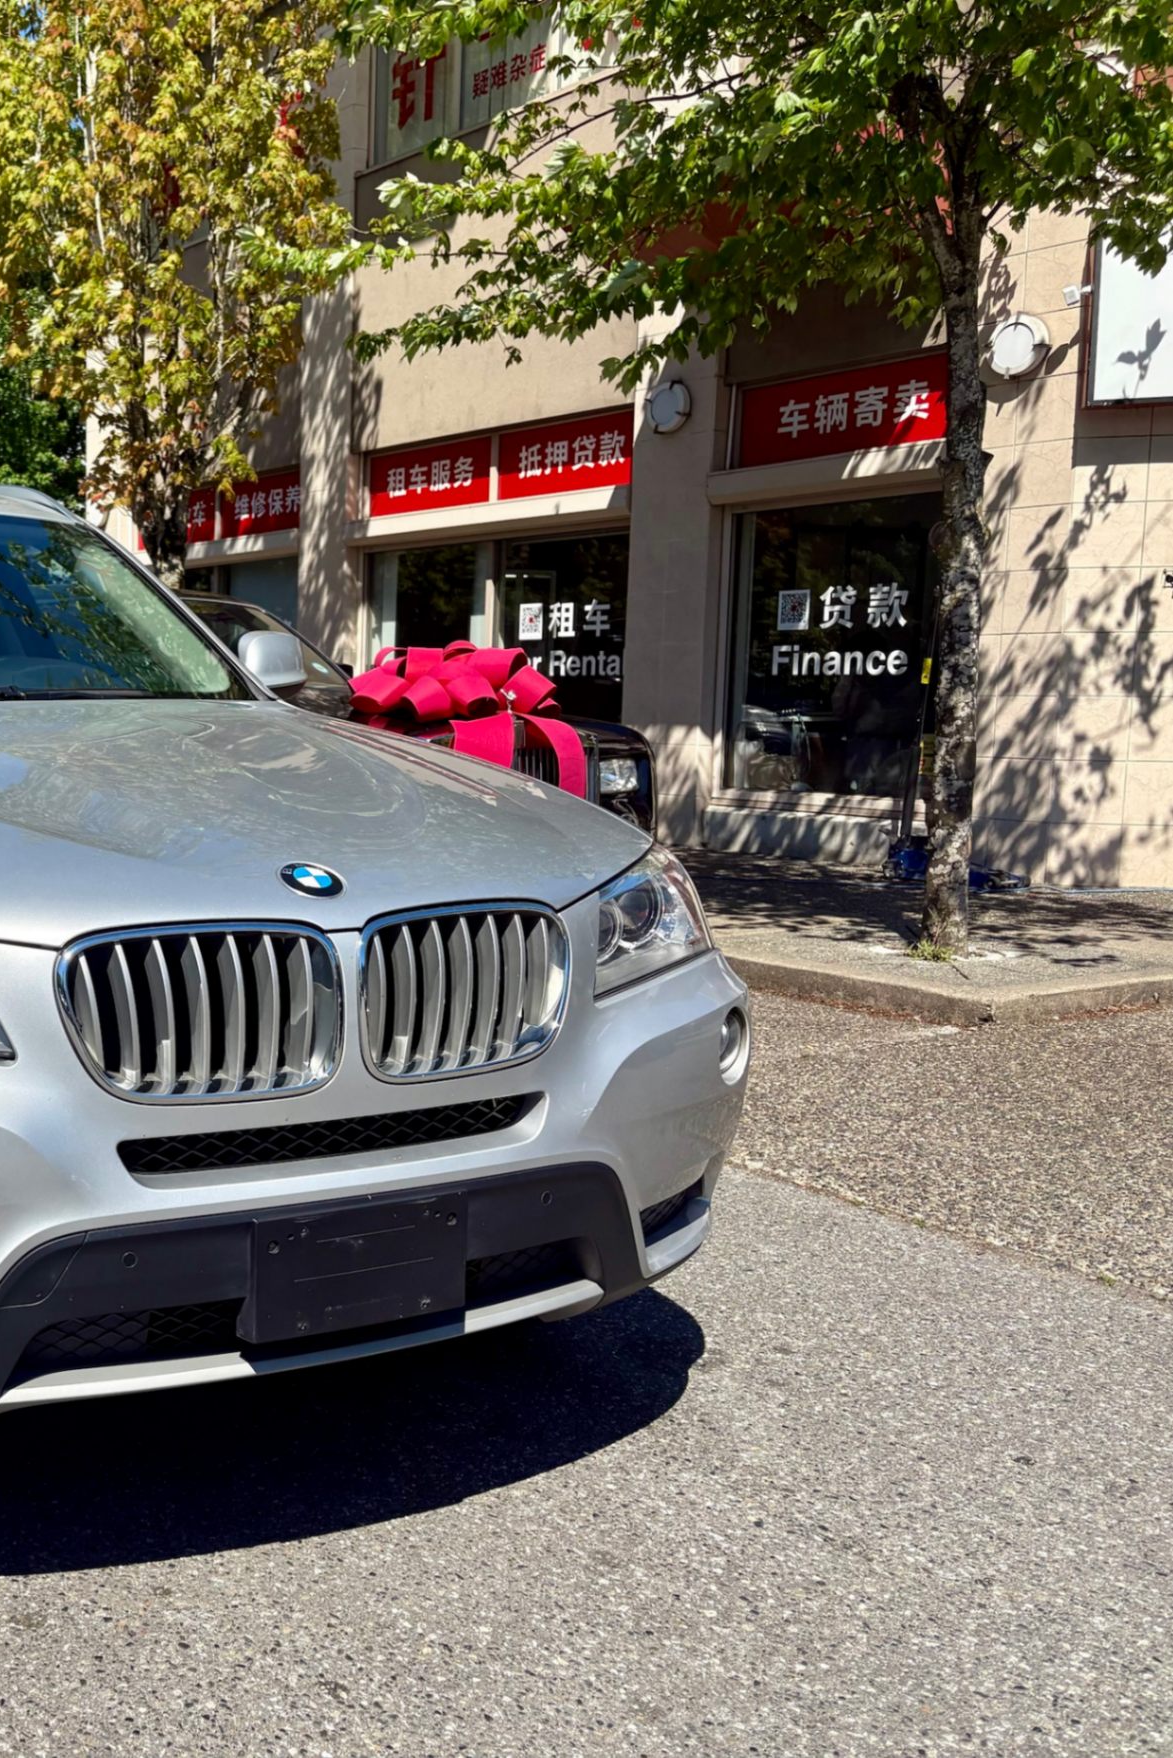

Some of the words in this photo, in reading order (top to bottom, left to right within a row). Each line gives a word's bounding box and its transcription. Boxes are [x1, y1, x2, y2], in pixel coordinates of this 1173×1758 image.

[472, 44, 547, 99] 疑难杂症
[777, 379, 930, 438] 车辆寄卖
[518, 430, 626, 479] 抵押贷款
[386, 456, 475, 498] 租车服务
[234, 484, 301, 520] 维修保养
[548, 598, 611, 639] 租车
[819, 582, 909, 629] 贷款
[549, 650, 622, 677] Renta
[771, 644, 909, 676] Finance
